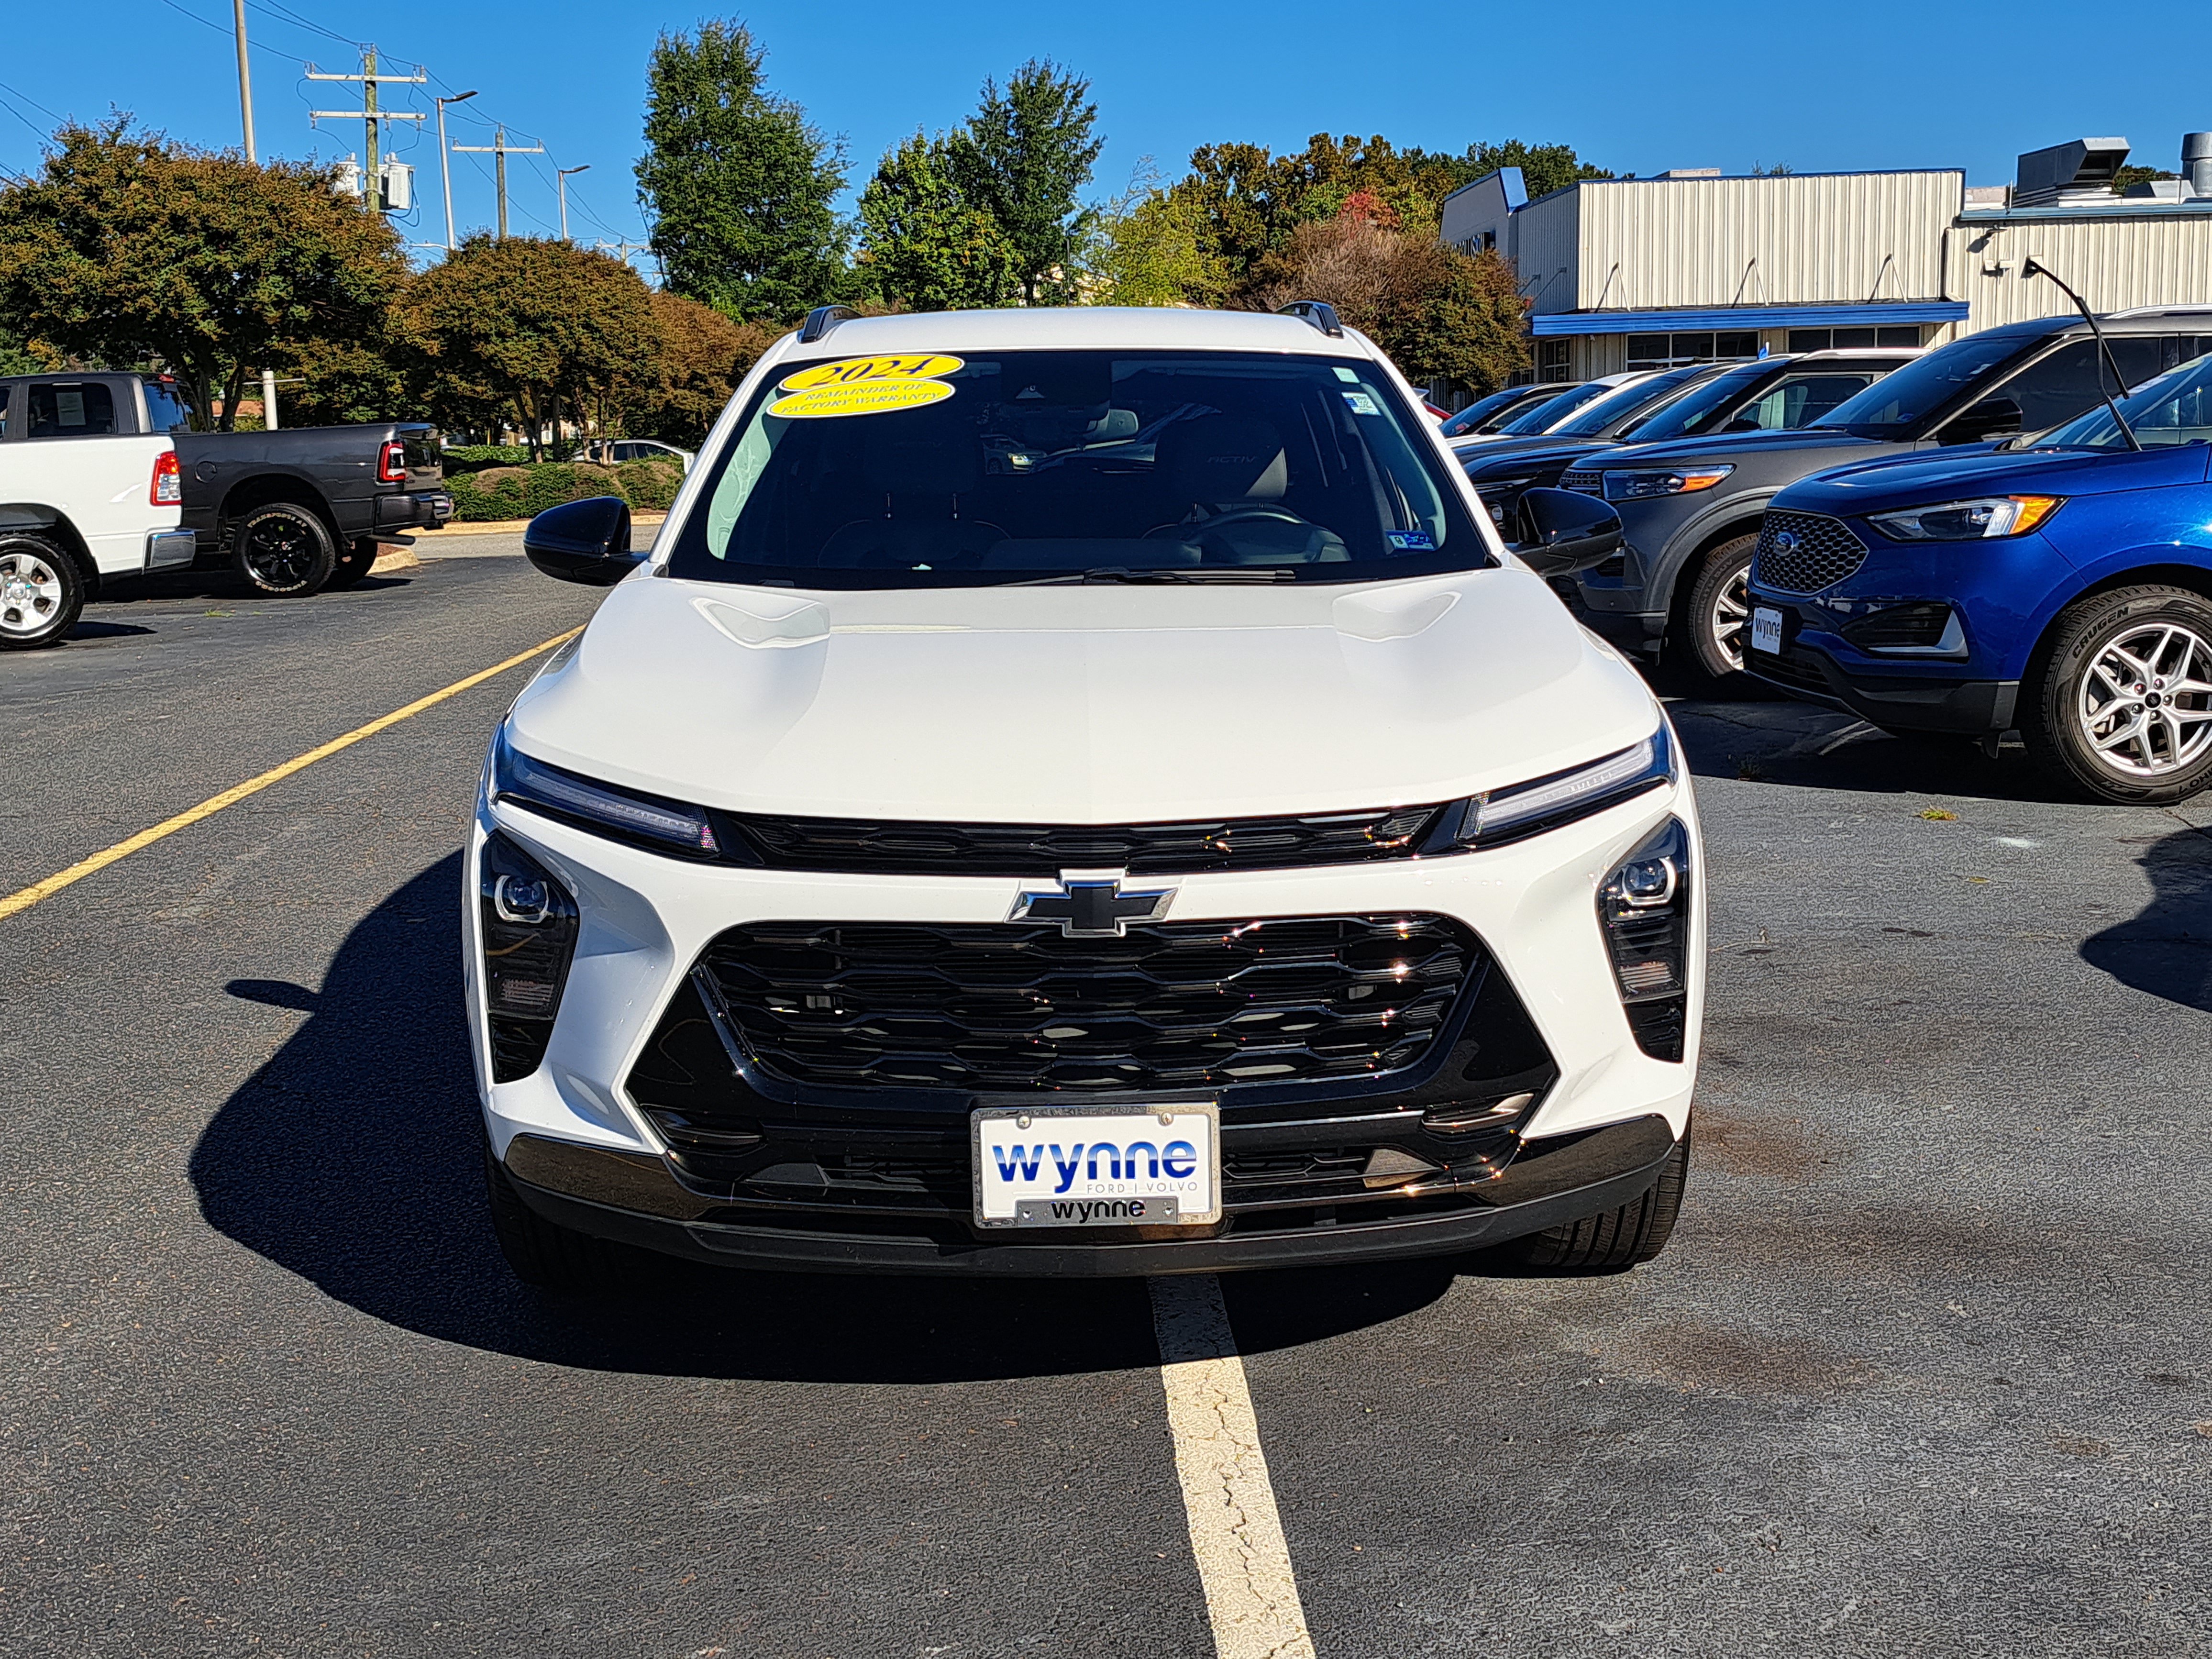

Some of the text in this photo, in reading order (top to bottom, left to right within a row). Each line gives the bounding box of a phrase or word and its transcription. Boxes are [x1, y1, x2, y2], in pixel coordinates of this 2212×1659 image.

[807, 357, 935, 387] 2024
[781, 392, 941, 413] FACTORY WARRANTY
[805, 383, 927, 400] REMAINDER OF
[992, 1140, 1197, 1194] wynne
[1086, 1181, 1198, 1194] FORD VOLVO
[1051, 1200, 1147, 1224] wynne
